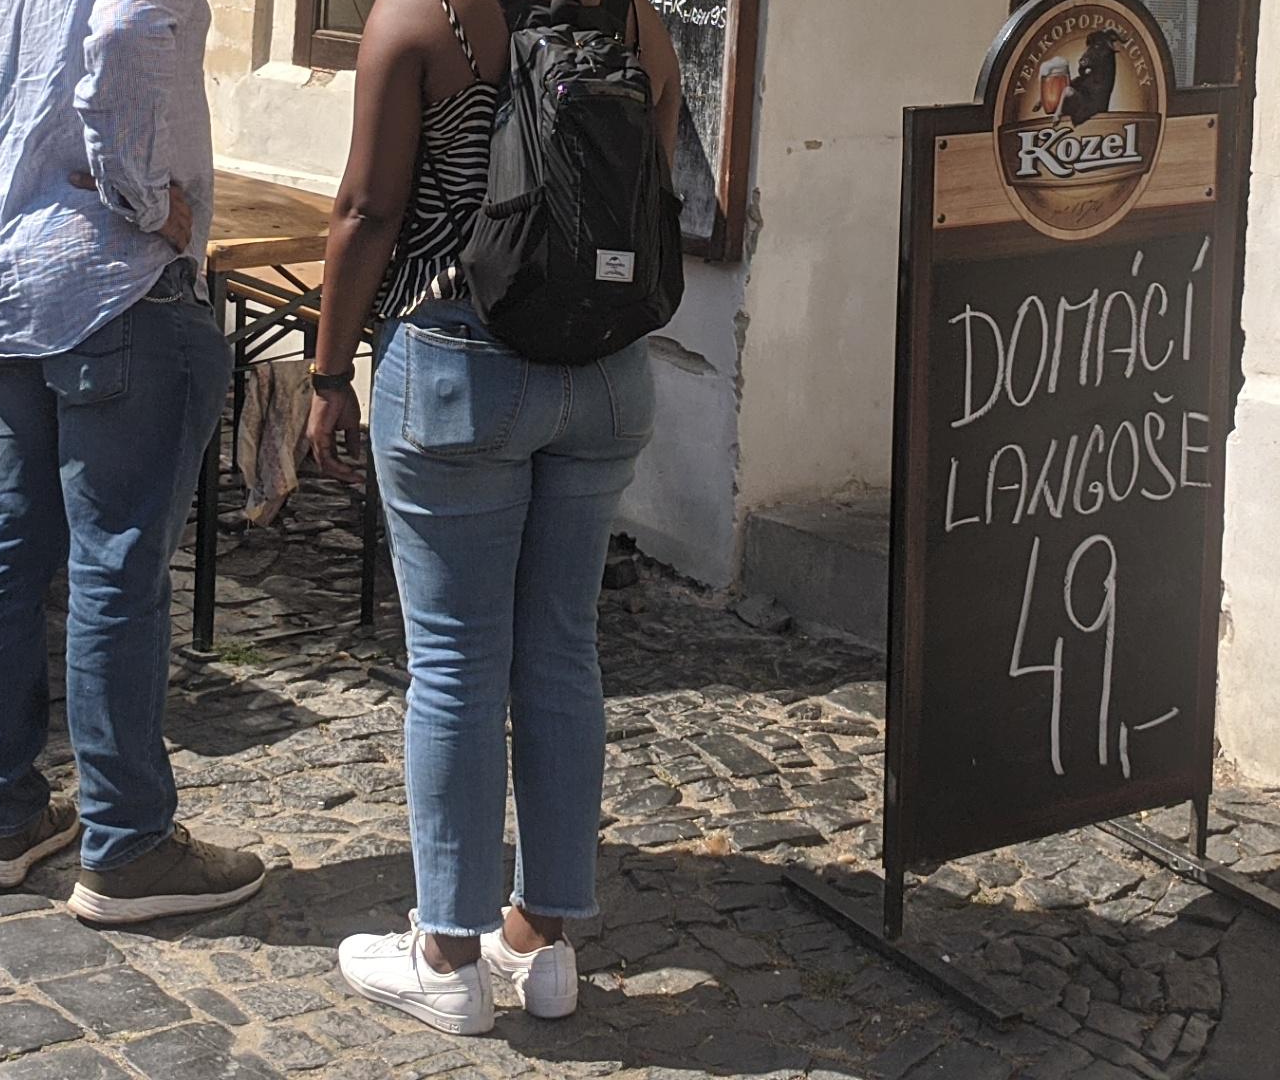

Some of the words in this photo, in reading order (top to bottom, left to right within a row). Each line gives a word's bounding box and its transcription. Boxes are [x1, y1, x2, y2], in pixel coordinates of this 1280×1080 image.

[1016, 122, 1143, 176] Kozel
[948, 235, 1211, 428] DOMÁCÍ
[945, 391, 1213, 532] LANGOŠE
